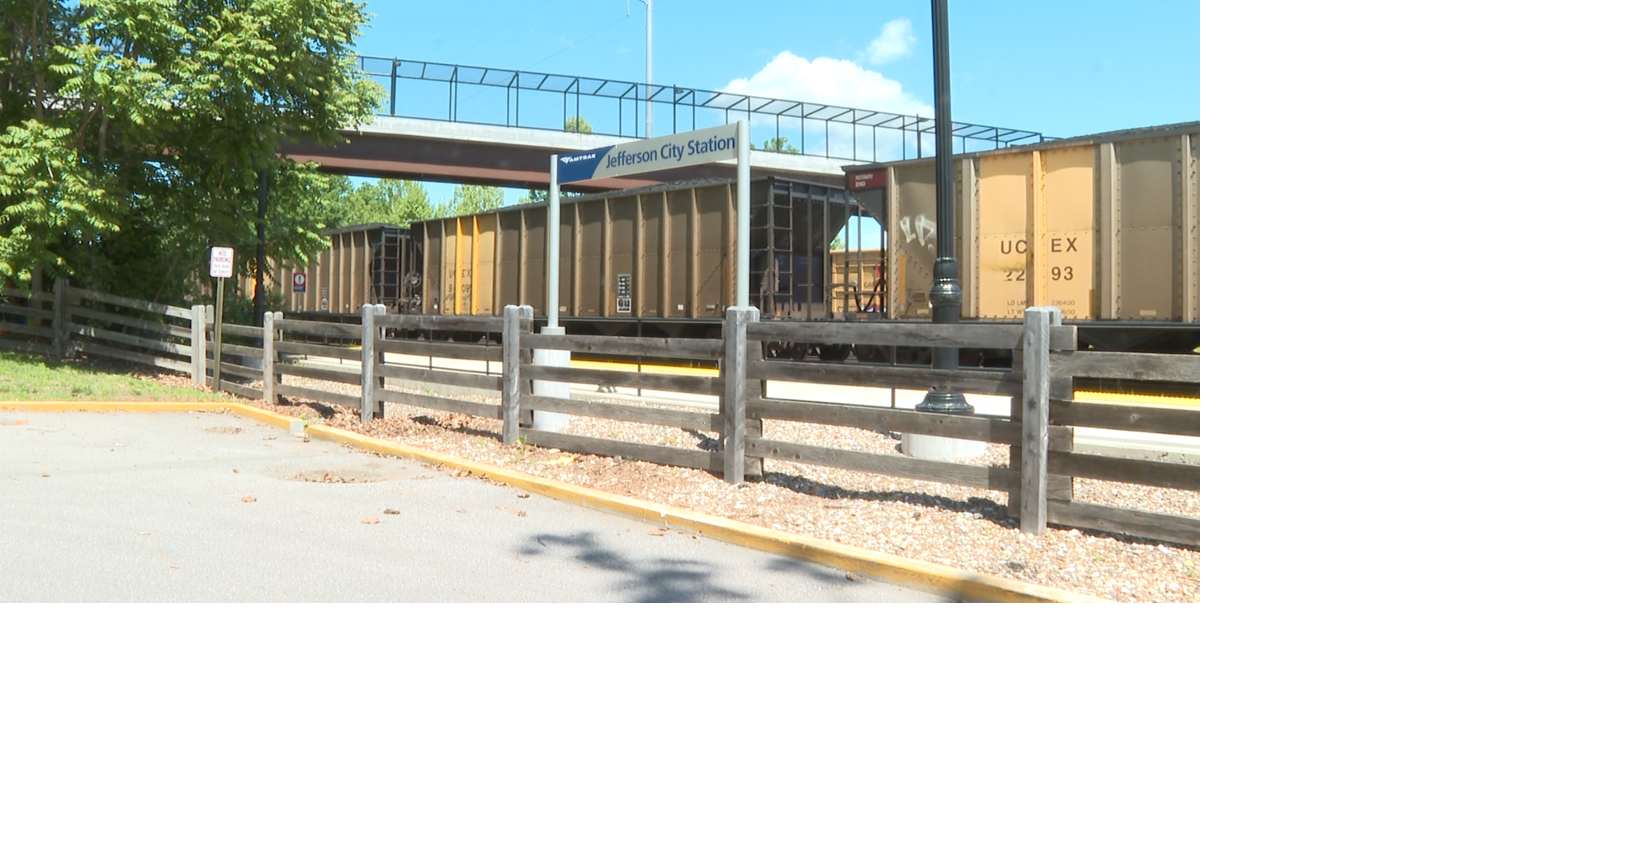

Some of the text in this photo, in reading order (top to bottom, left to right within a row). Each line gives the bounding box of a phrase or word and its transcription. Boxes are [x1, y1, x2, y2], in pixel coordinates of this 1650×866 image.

[570, 153, 597, 162] AMTRAK
[606, 135, 736, 169] Jefferson City Station
